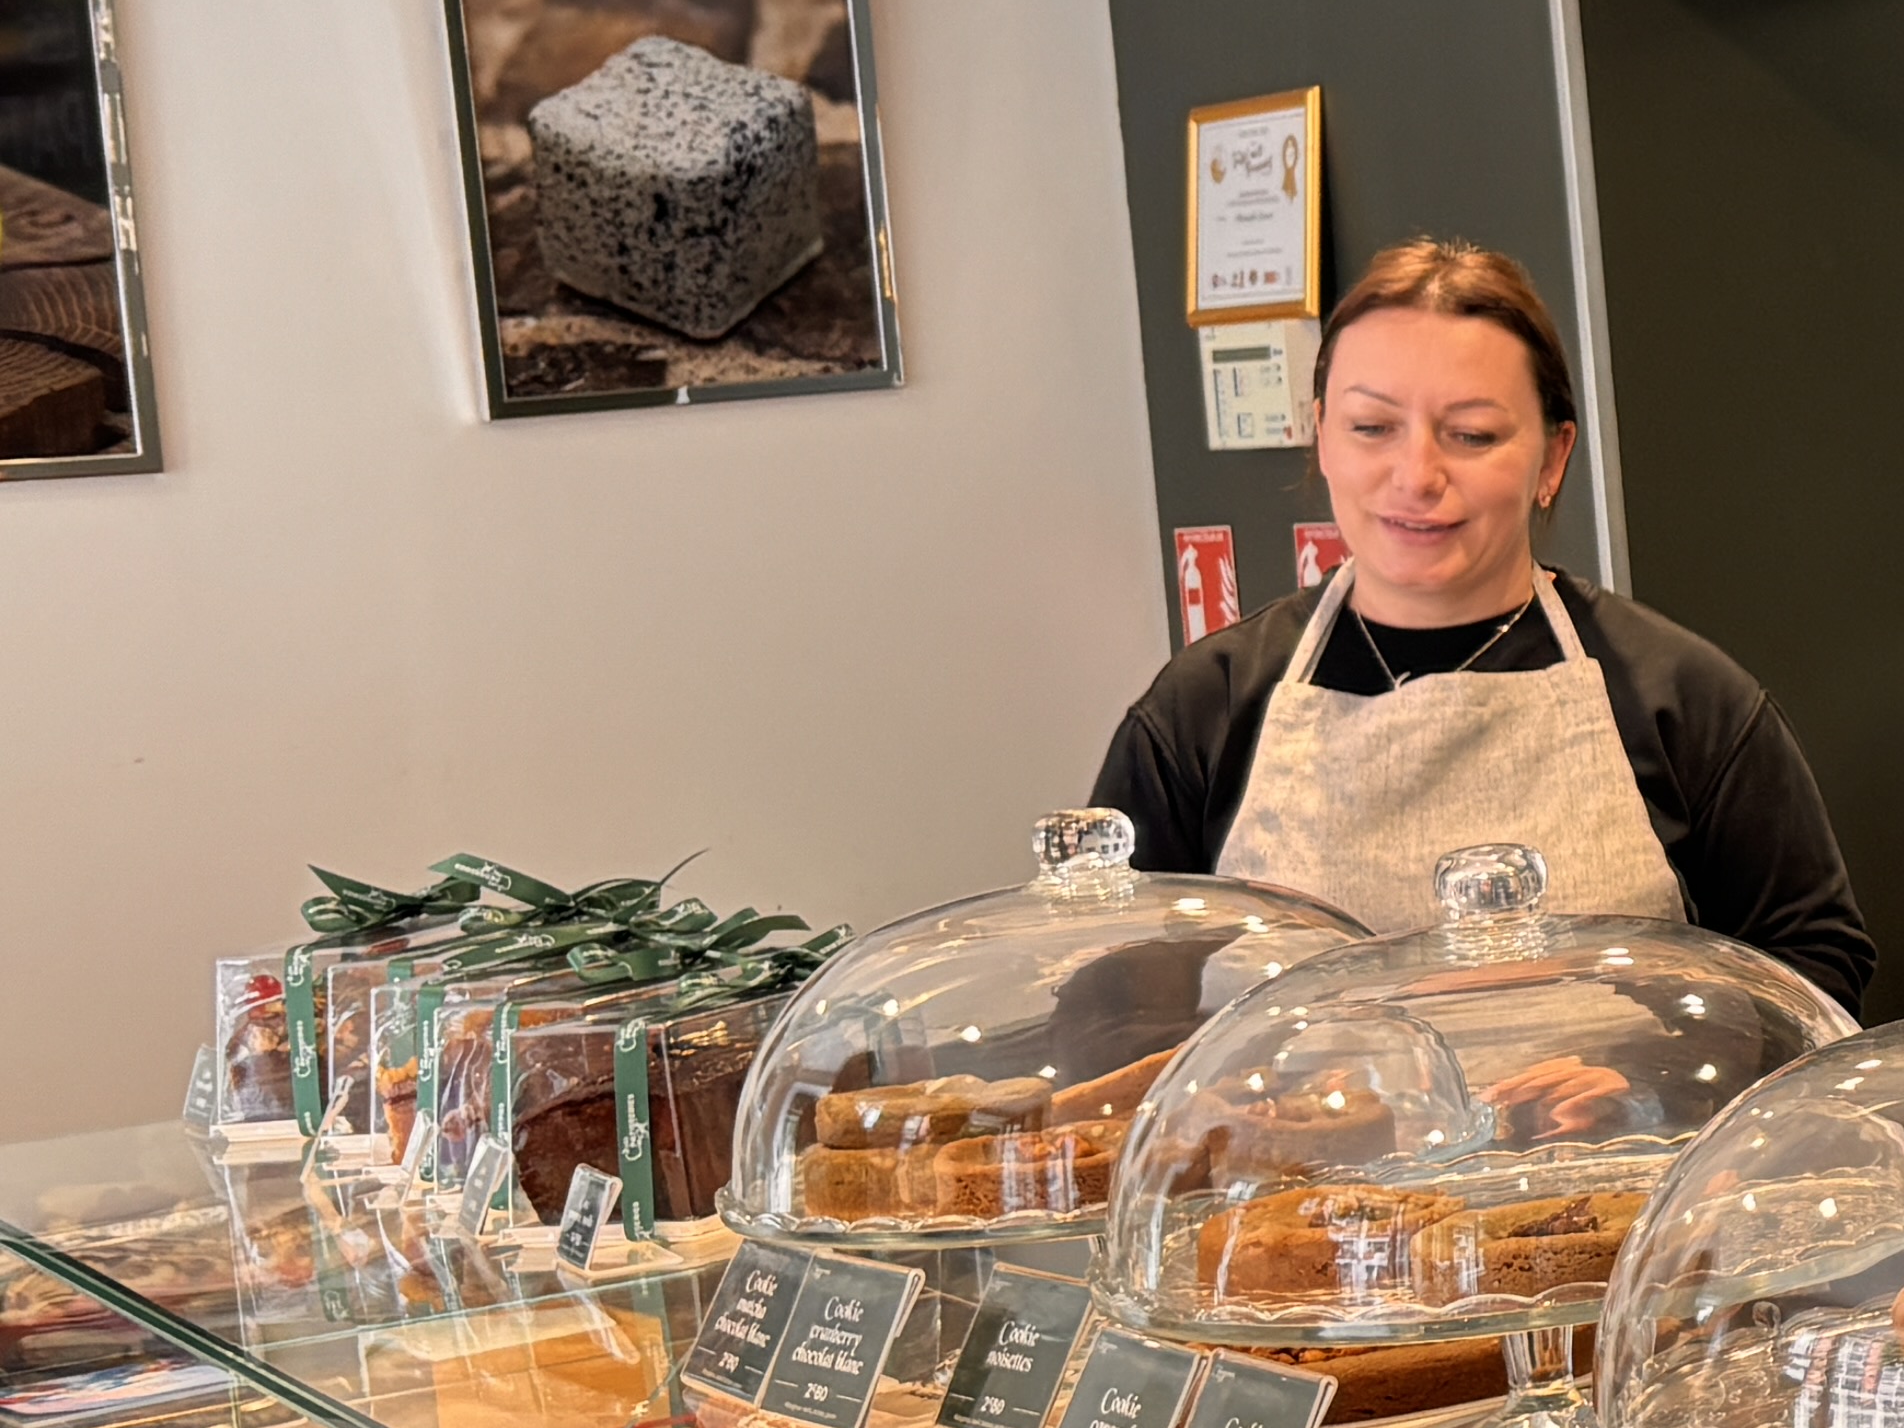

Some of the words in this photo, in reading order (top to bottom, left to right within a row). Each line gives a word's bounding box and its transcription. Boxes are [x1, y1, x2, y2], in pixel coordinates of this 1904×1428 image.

[745, 1269, 778, 1297] Cookie
[824, 1296, 864, 1323] Cookie
[998, 1320, 1041, 1348] Cookie
[791, 1341, 835, 1369] chocolat
[834, 1350, 864, 1375] blanc
[1100, 1387, 1142, 1419] Cookie
